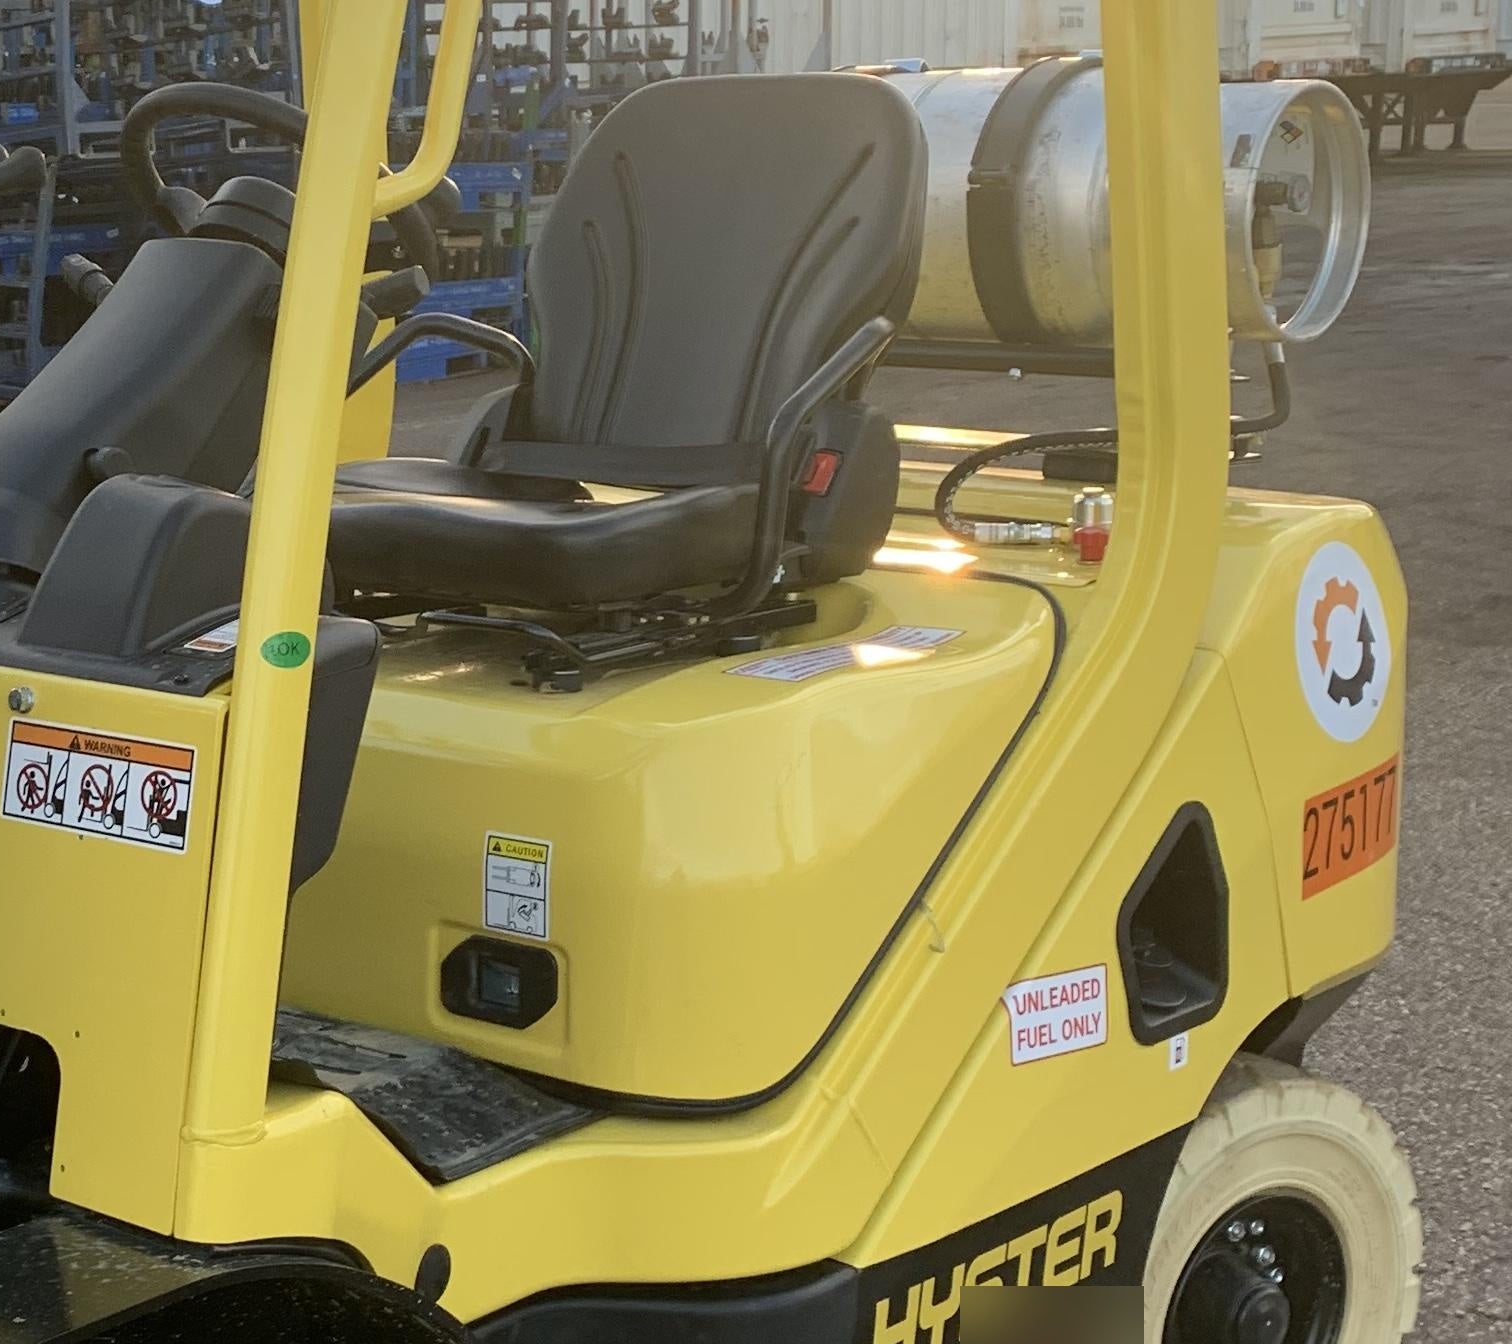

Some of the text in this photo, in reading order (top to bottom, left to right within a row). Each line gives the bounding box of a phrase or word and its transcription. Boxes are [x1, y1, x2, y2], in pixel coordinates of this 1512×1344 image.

[84, 739, 132, 757] WARNING
[1303, 764, 1397, 881] 275177
[505, 843, 544, 858] CAUTION
[1013, 978, 1101, 1017] UNLEADED
[1017, 1011, 1102, 1052] FUEL ONLY
